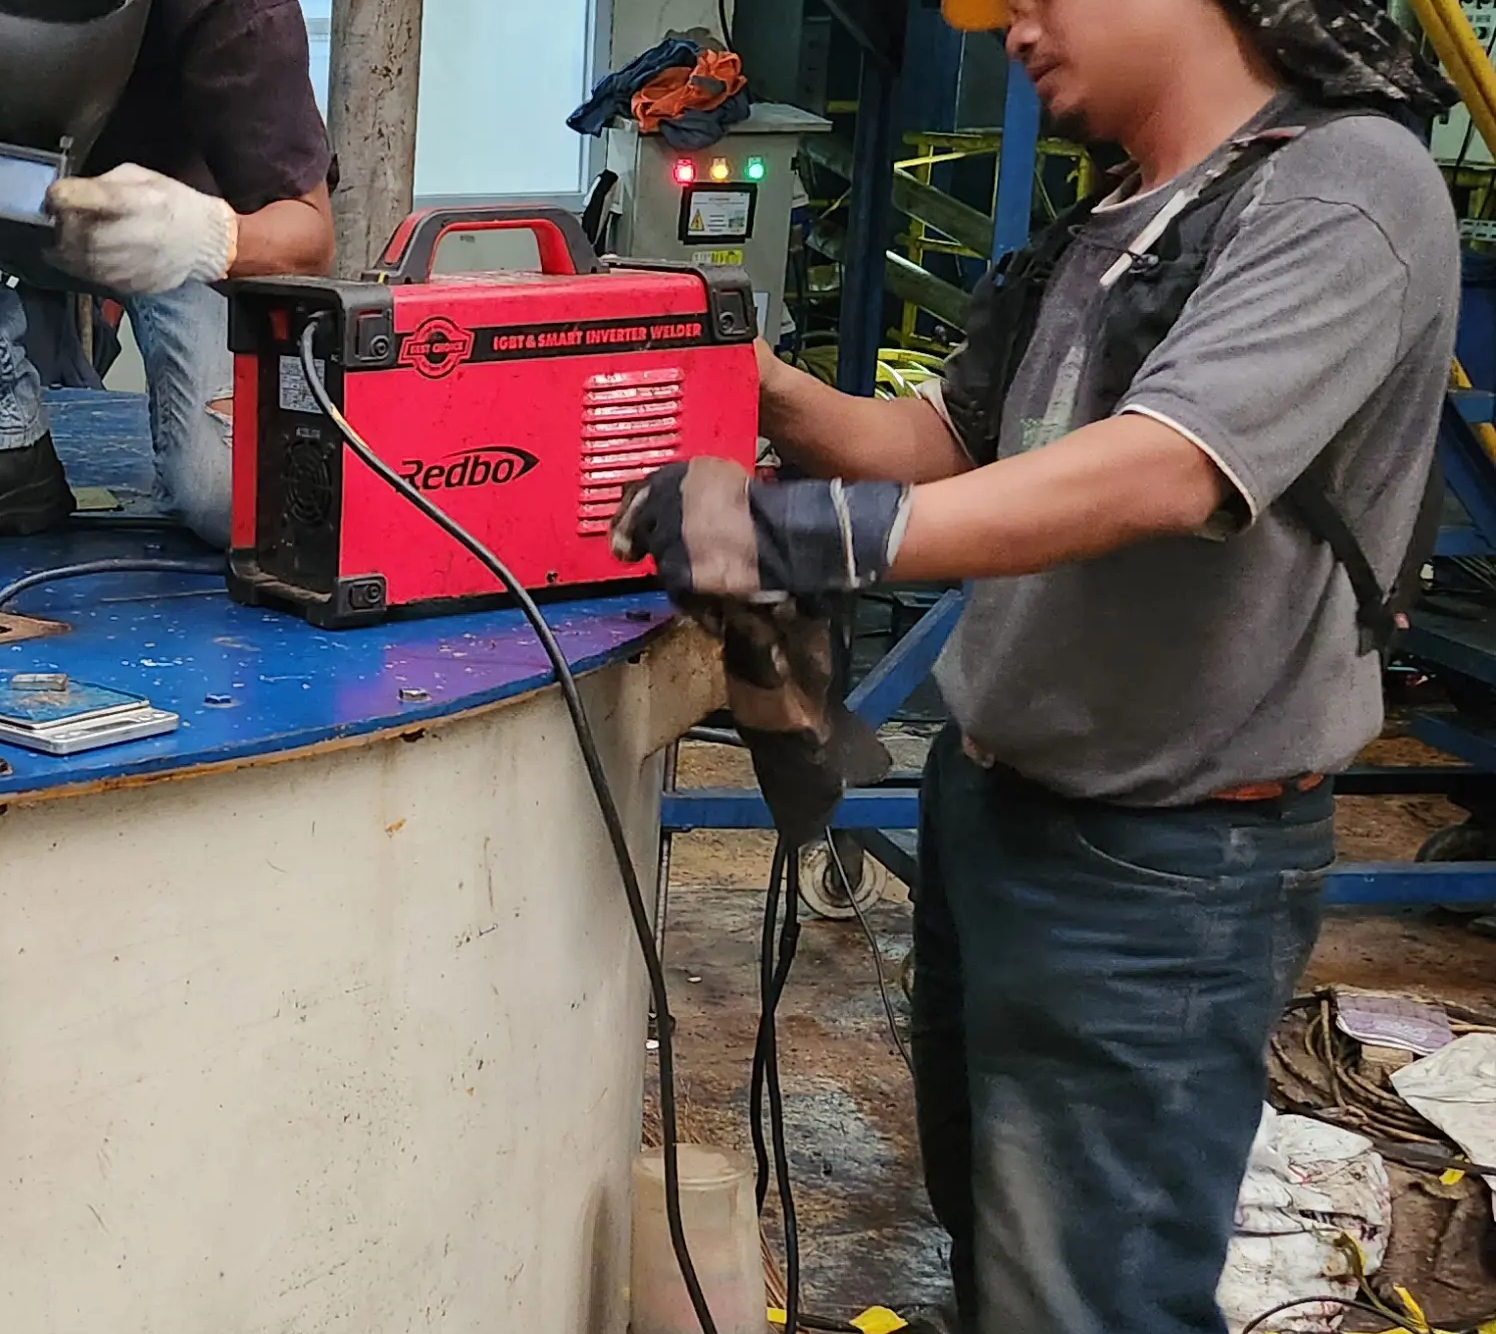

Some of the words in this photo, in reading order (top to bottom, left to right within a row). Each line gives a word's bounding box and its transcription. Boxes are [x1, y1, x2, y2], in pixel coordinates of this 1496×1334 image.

[538, 329, 584, 348] SMART
[586, 326, 647, 344] INVERTER
[650, 323, 702, 339] WELDER
